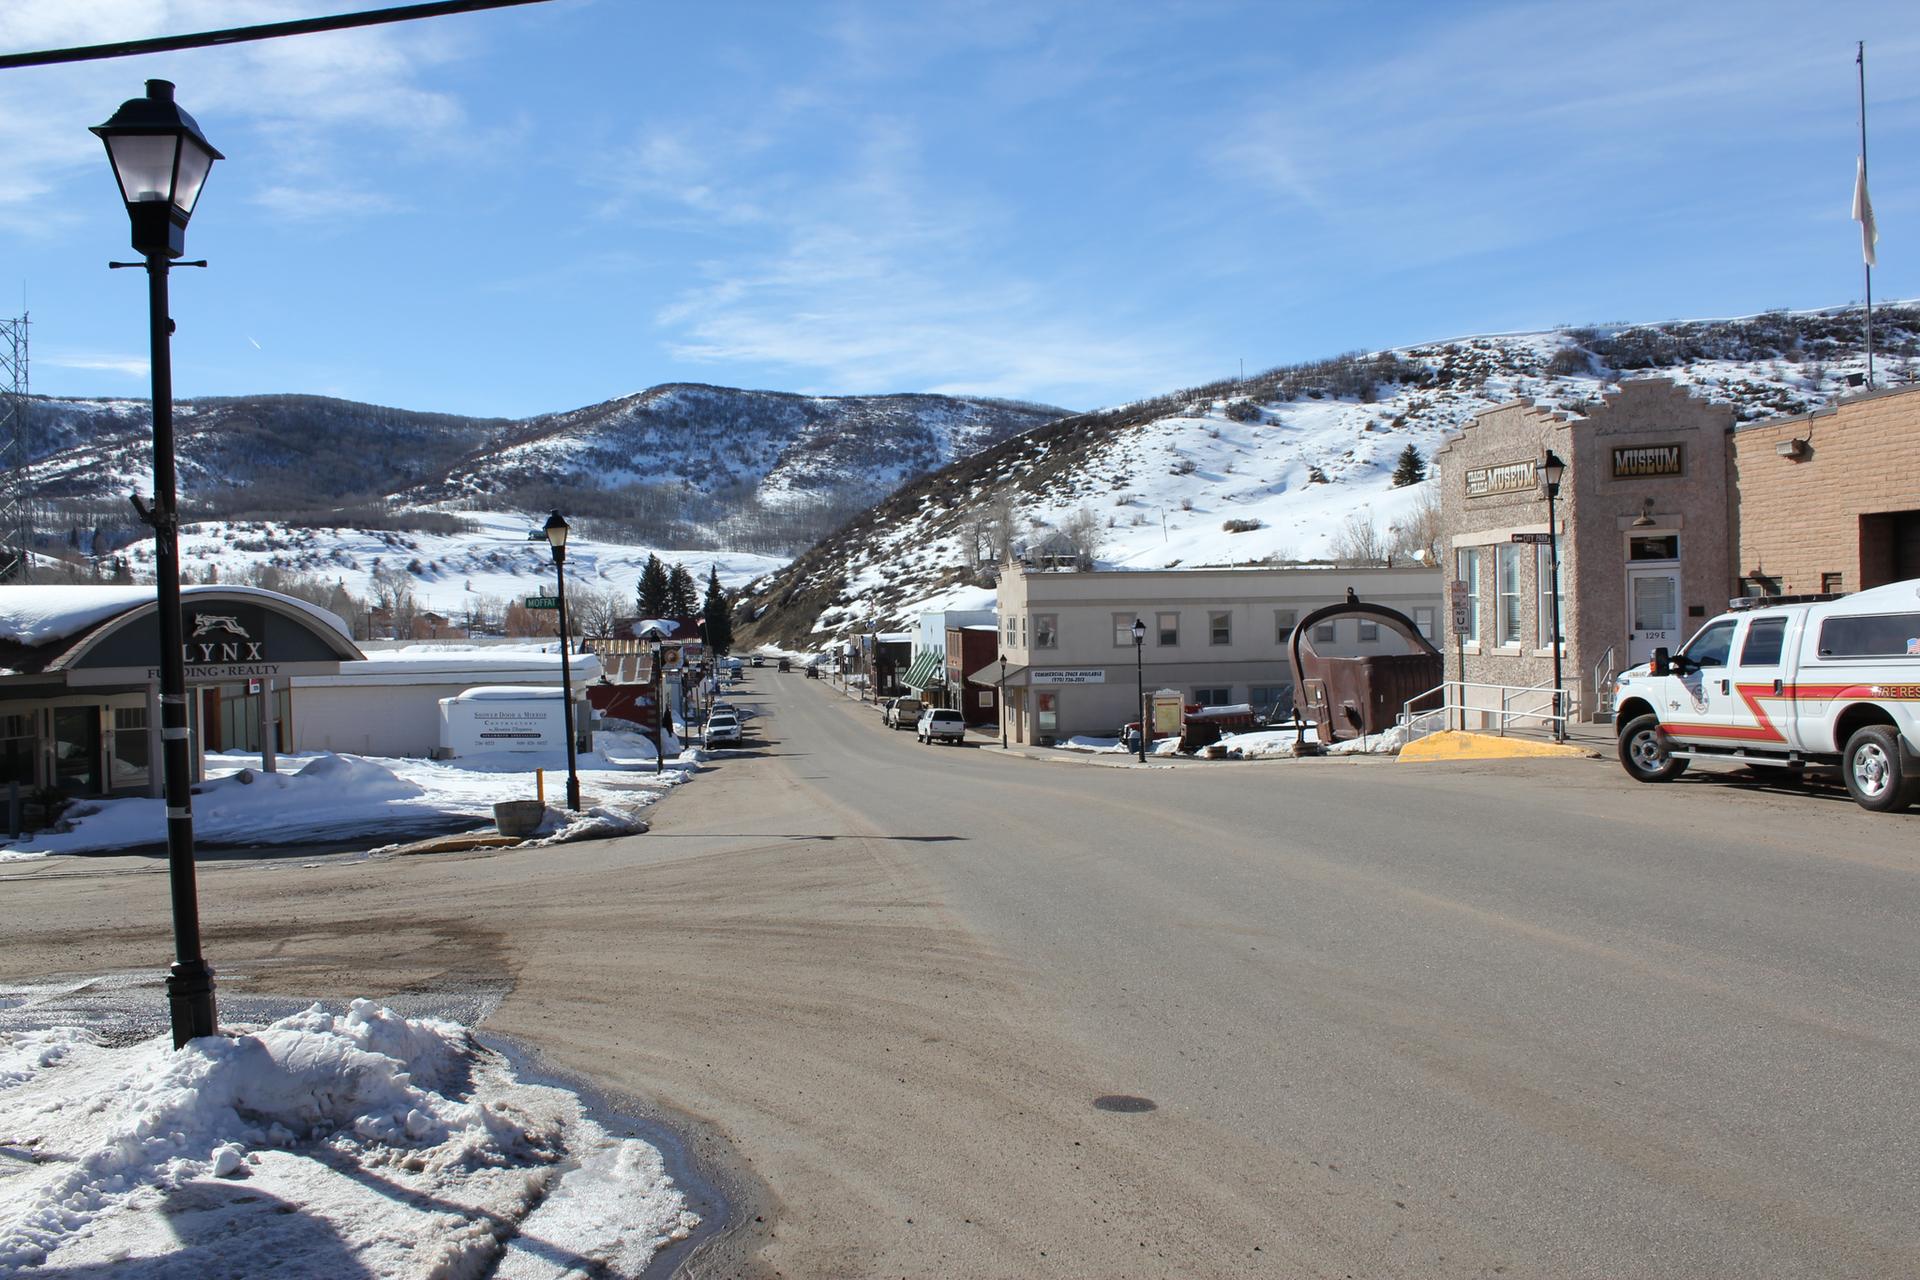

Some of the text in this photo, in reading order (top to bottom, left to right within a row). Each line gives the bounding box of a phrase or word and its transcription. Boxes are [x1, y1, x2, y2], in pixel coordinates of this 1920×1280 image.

[1615, 447, 1679, 475] MUSEUM
[1487, 462, 1536, 491] MUSEUM
[1523, 534, 1548, 542] CITY PARK
[527, 598, 556, 608] MOFFAT
[1645, 631, 1660, 639] 129
[182, 642, 262, 662] LYNX
[228, 665, 280, 676] REALTY
